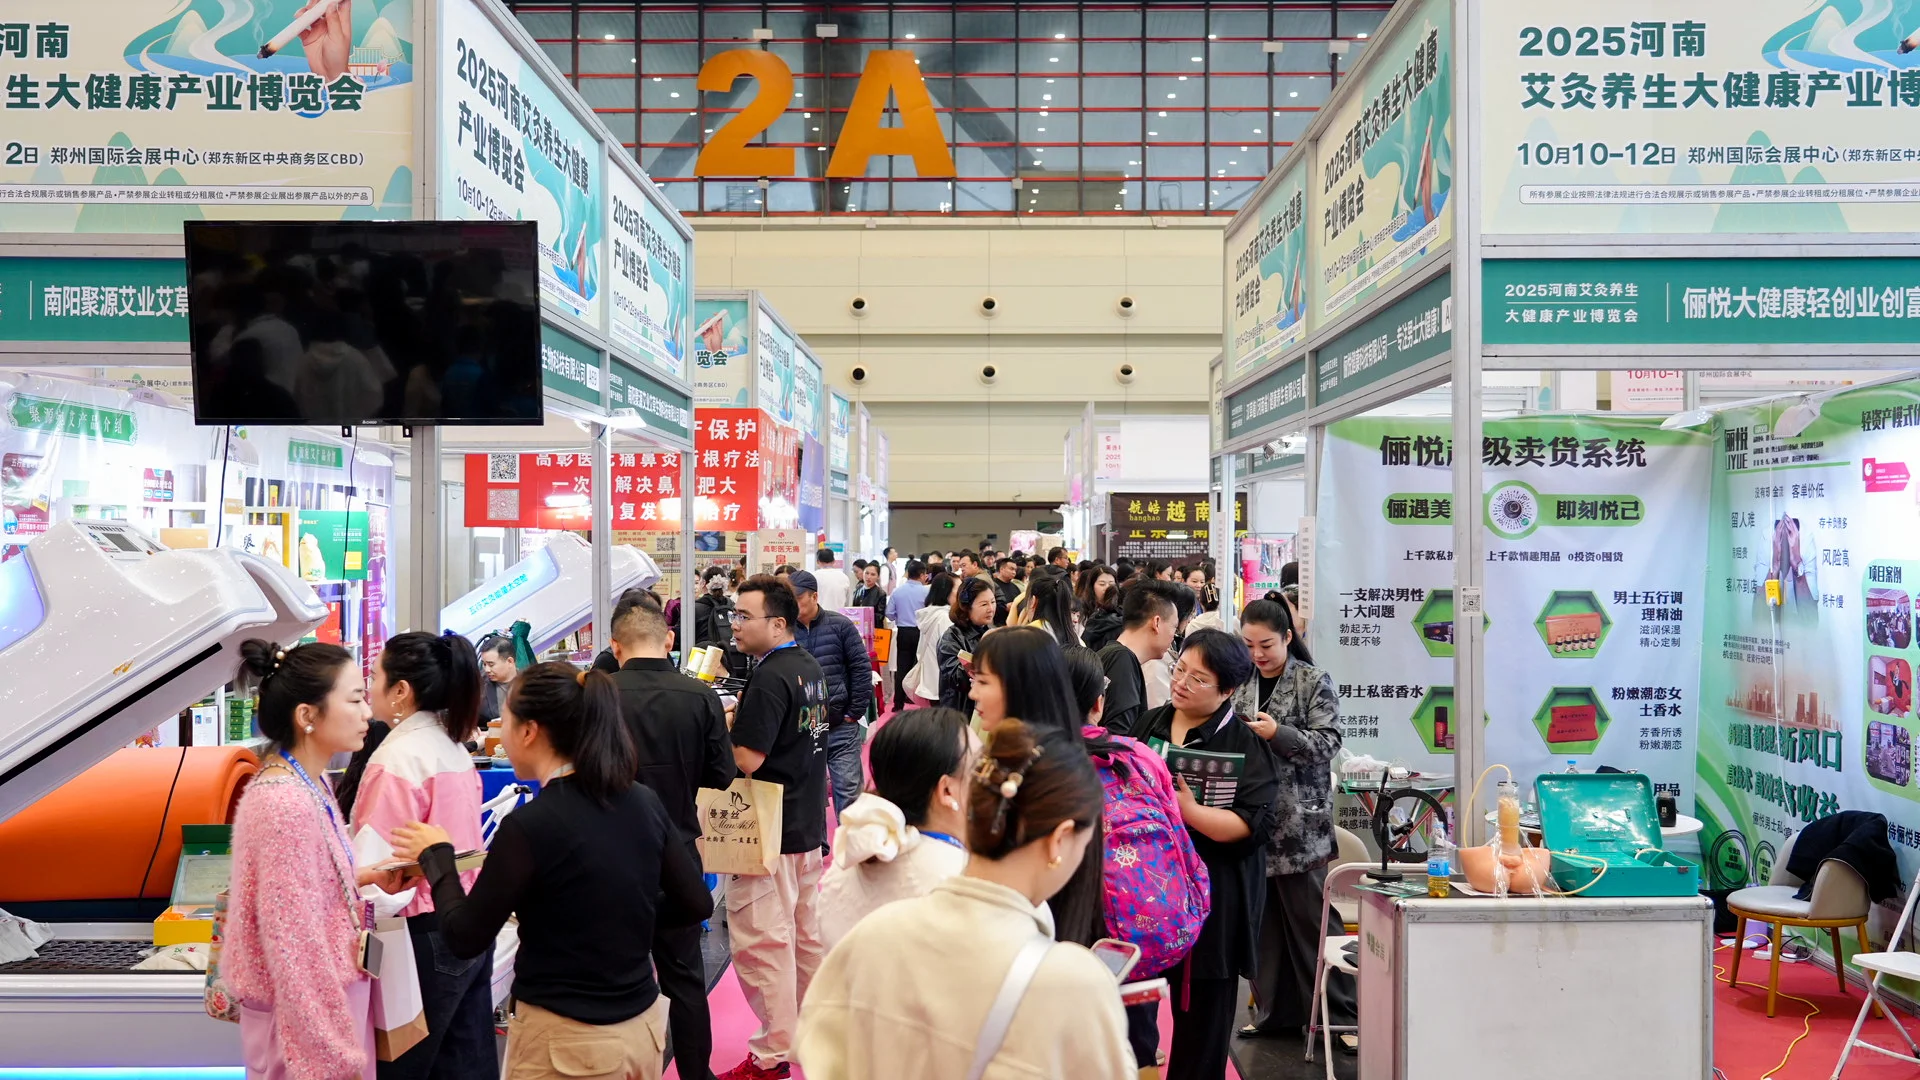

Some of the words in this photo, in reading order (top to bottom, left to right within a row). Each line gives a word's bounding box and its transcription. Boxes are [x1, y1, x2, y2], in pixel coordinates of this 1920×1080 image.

[1519, 21, 1706, 57] 2025河南
[6, 73, 364, 111] 生大健康产业博览会
[1520, 71, 1920, 110] 艾灸养生大健康产业博
[457, 37, 589, 196] 2025河南艾灸养生大健康
[694, 49, 957, 178] 2A
[1324, 27, 1438, 196] 2025河南艾灸养生大健康
[458, 100, 525, 193] 产业博览会
[1518, 143, 1675, 165] 10月10-12日
[1688, 145, 1920, 165] 郑州国际会展中心(郑东新区中
[1324, 173, 1365, 247] 产业博览会
[614, 238, 648, 292] 产业博览会
[1505, 283, 1638, 297] 2025河南艾灸养生
[1505, 309, 1638, 323] 大健康产业博览会
[697, 350, 728, 366] 览会
[1628, 370, 1684, 380] 10月10-1
[1380, 435, 1647, 468] 俪悦级卖货系统
[1791, 483, 1825, 499] 客单价低
[1387, 499, 1451, 520] 俪遇美
[1556, 500, 1641, 521] 即刻悦己
[1129, 514, 1160, 522] hanghao
[1731, 512, 1756, 529] 留人难
[1486, 550, 1561, 562] 上千款情趣用品
[1822, 549, 1850, 568] 风险高
[1869, 565, 1902, 584] 项目案例
[1339, 587, 1424, 602] 一支解决男性
[1613, 590, 1683, 605] 男士五行调
[1339, 604, 1395, 619] 十大问题
[1641, 607, 1683, 622] 理精油
[1339, 623, 1381, 634] 勃起无力
[1640, 624, 1681, 635] 滋润保湿
[1339, 635, 1381, 647] 硬度不够
[1640, 637, 1681, 648] 精心定制
[1338, 684, 1424, 699] 男士私密香水
[1611, 686, 1682, 701] 粉嫩潮恋女
[1640, 703, 1682, 717] 士香水
[1640, 727, 1682, 738] 芳香所诱
[1640, 739, 1682, 751] 粉嫩潮恋
[1779, 726, 1842, 772] 新风口
[1339, 806, 1369, 818] 润滑控
